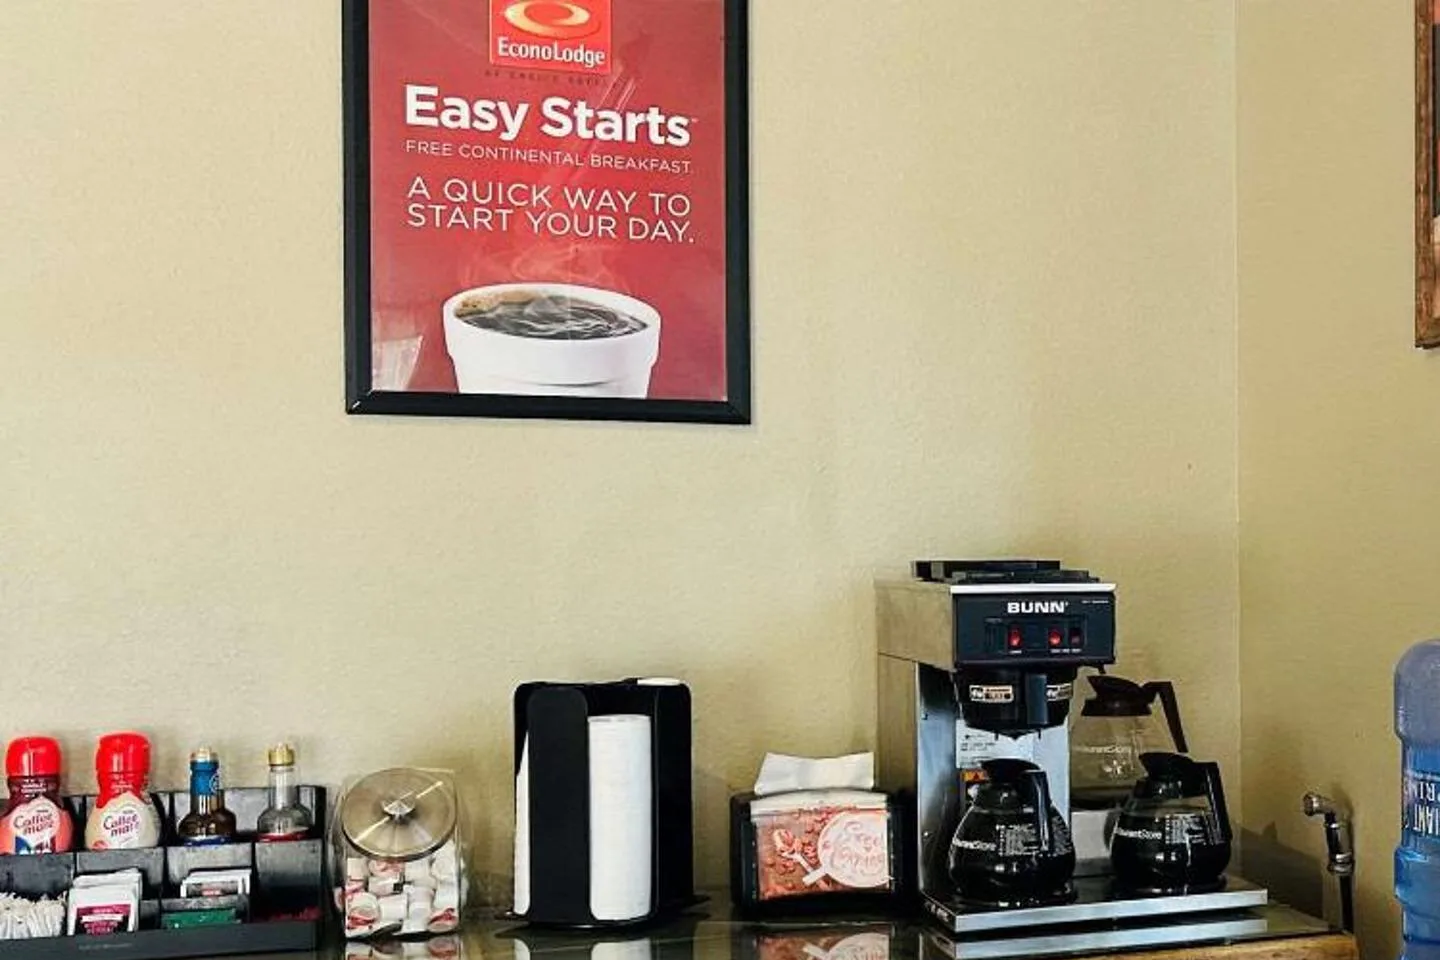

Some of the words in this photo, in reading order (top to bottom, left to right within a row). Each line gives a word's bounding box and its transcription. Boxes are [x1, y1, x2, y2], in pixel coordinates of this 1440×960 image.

[497, 36, 606, 68] EconoLodge
[404, 83, 531, 141] Easy
[540, 95, 691, 147] Starts
[406, 140, 453, 156] FREE
[459, 144, 584, 168] CONTINENTAL
[407, 177, 430, 199] A
[443, 179, 551, 208] QUICK
[564, 188, 634, 213] WAY
[649, 193, 691, 216] TO
[407, 203, 514, 232] START
[526, 210, 617, 238] YOUR
[628, 219, 696, 244] DAY.
[1007, 602, 1066, 614] BUNN
[14, 813, 53, 829] Coffee
[103, 814, 138, 830] Coffee
